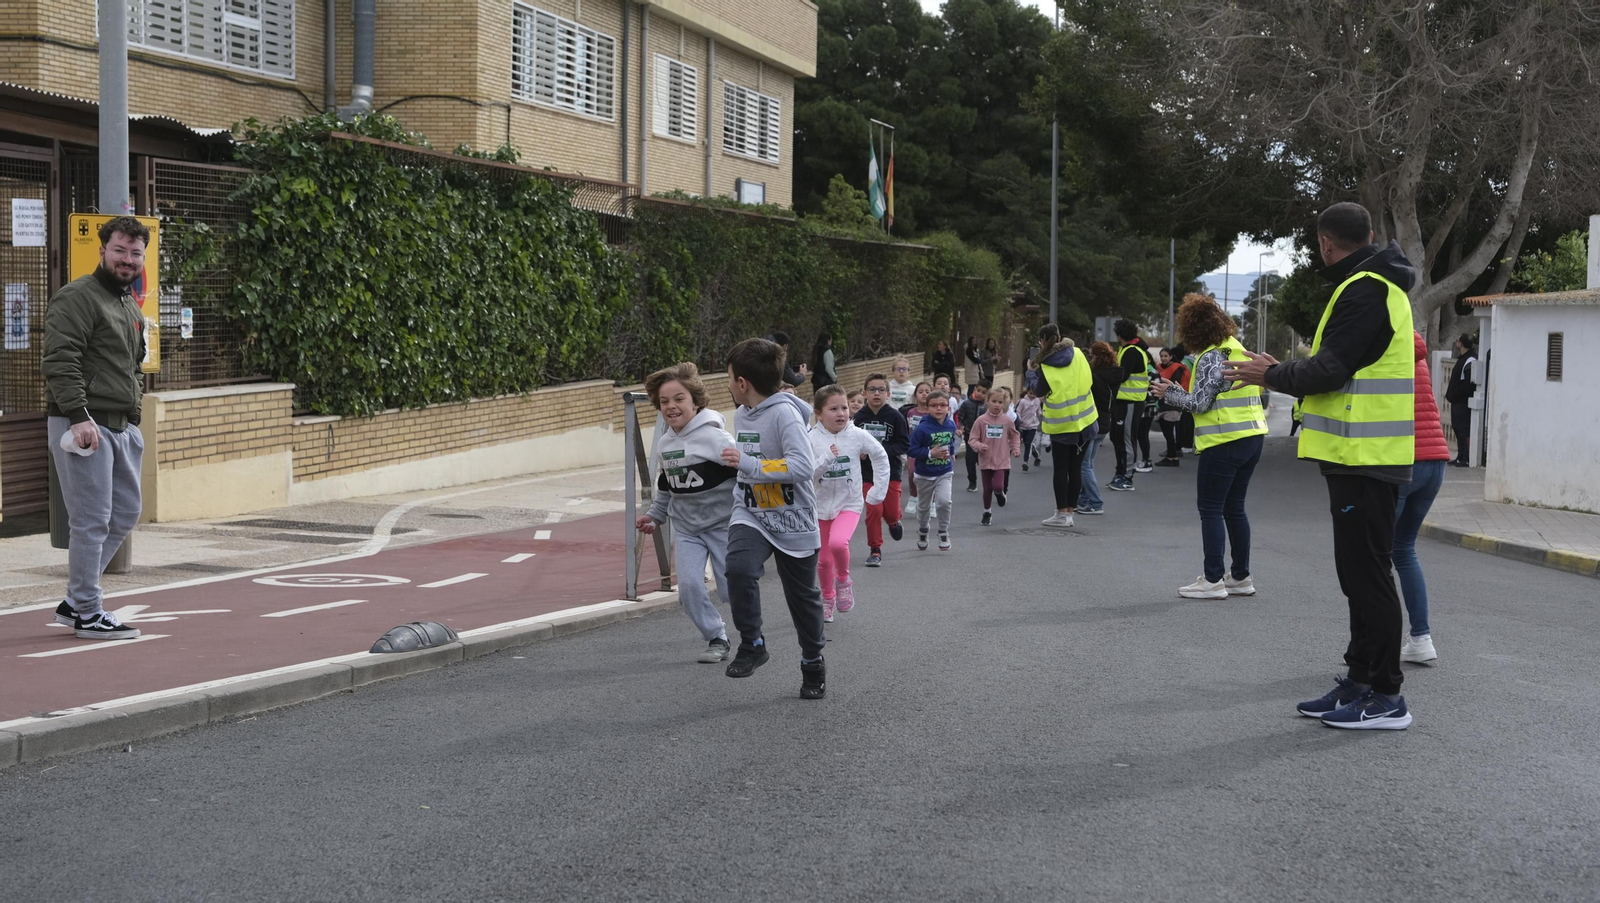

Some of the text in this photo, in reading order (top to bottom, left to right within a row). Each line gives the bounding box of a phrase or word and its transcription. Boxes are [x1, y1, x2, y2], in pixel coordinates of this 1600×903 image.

[743, 443, 754, 453] 072
[667, 460, 680, 468] 092
[667, 469, 705, 489] ILA
